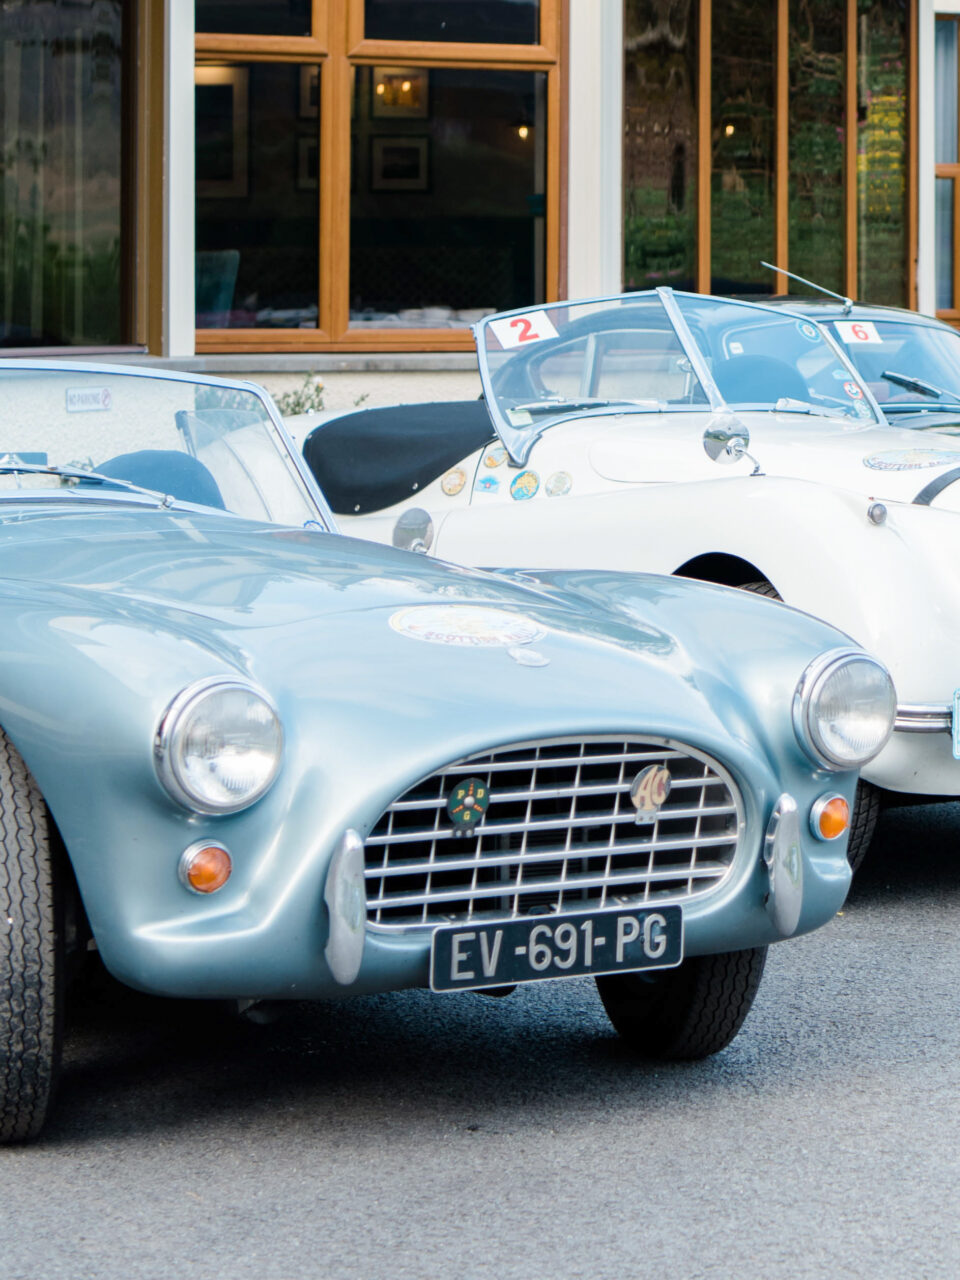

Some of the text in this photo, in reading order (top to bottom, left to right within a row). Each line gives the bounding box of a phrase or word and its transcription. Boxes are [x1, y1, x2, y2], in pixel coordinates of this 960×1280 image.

[510, 318, 540, 342] 2
[851, 324, 869, 341] 6
[457, 788, 485, 799] P D
[632, 766, 669, 809] AC
[463, 810, 471, 820] G
